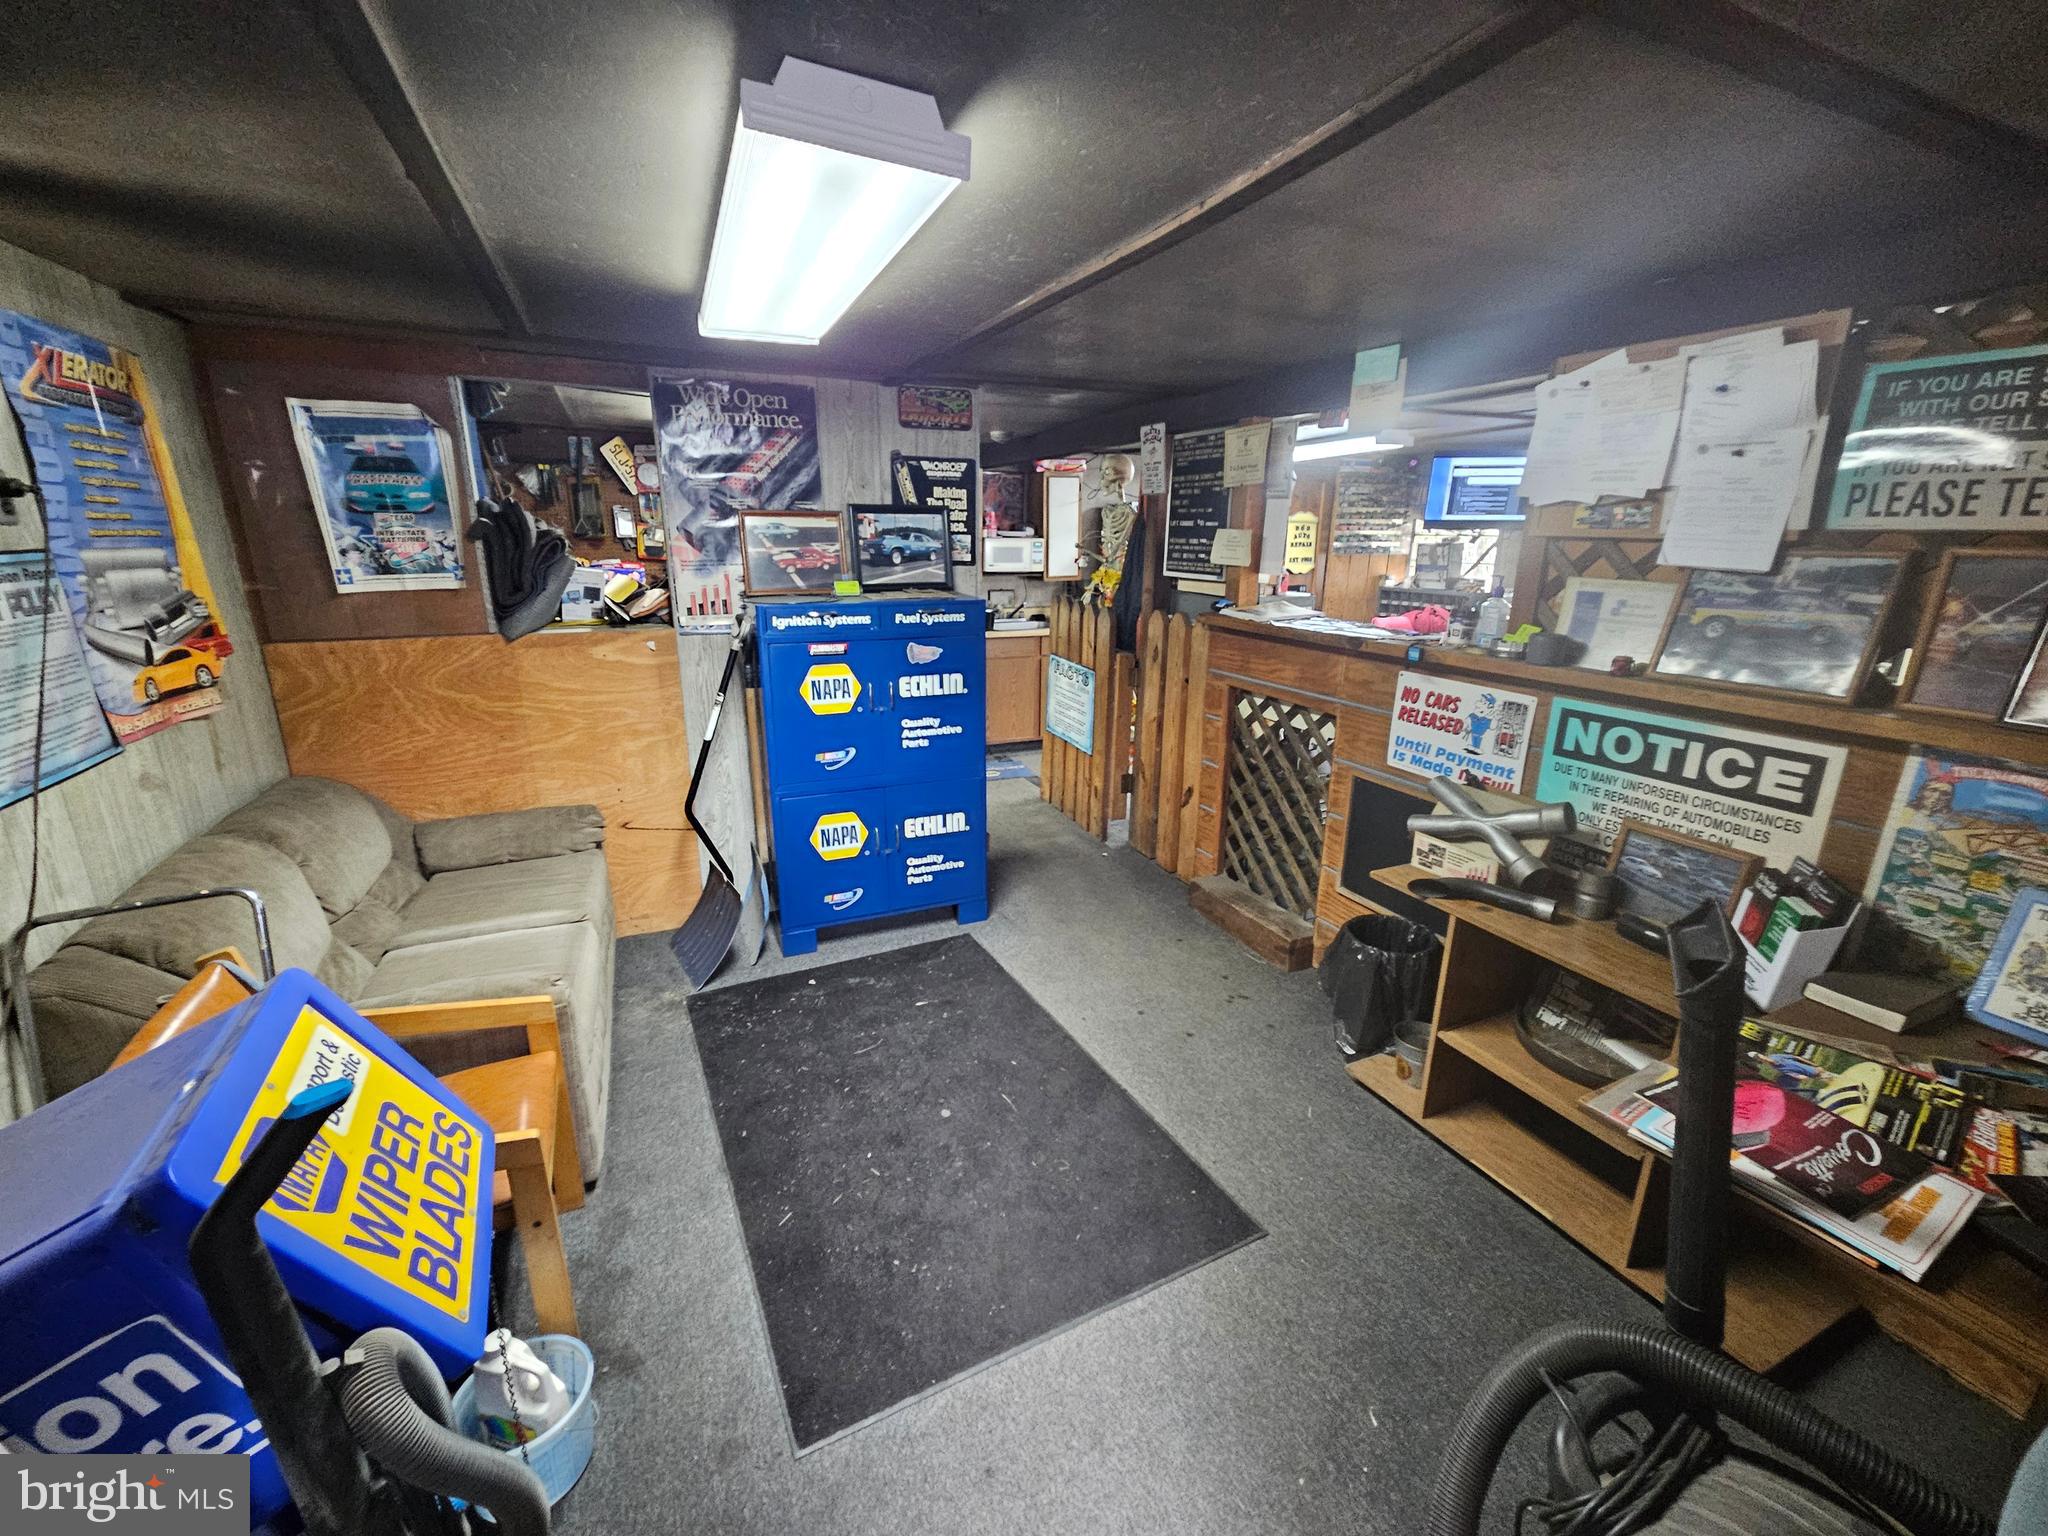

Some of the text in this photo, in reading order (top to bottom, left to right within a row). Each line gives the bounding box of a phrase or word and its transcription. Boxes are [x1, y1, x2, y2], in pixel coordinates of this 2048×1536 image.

[29, 341, 128, 394] XLERATOR
[1887, 380, 1911, 398] IF
[1918, 374, 1969, 394] YOU
[1973, 367, 2034, 390] ARE
[676, 384, 788, 412] Wide Open
[1899, 391, 2030, 417] WITH OUR
[670, 403, 803, 429] Pformance.
[1973, 414, 2038, 433] TELL
[921, 461, 967, 472] MONROE
[926, 497, 967, 510] The Road
[933, 486, 967, 500] Making
[1843, 476, 2048, 518] PLEASE TE
[949, 511, 967, 521] afer
[771, 614, 871, 630] Ignition Systems
[895, 612, 966, 625] Fuel Systems
[811, 677, 852, 701] NAPA
[1400, 685, 1462, 714] NO CARS
[901, 716, 941, 729] Quality
[901, 724, 963, 739] Automotive
[1398, 705, 1465, 736] RELEASED
[902, 738, 930, 749] Parts
[1392, 749, 1406, 762] Is
[1410, 754, 1454, 777] Made
[1394, 735, 1516, 780] Until Payment
[1562, 716, 1812, 803] NOTICE
[1554, 761, 1803, 834] DUE TO MANY UNFORSEEN CIRCUMSTANCES
[1569, 781, 1580, 792] IN
[1581, 783, 1601, 798] THE
[1603, 789, 1661, 814] REPAIRING
[1663, 805, 1680, 817] OF
[1592, 801, 1608, 814] WE
[1578, 811, 1622, 833] ONLY ES
[821, 825, 859, 848] NAPA
[906, 853, 944, 867] Quality
[906, 860, 965, 876] Automotive
[907, 874, 933, 885] Parts
[307, 1039, 340, 1090] port &
[344, 1100, 425, 1260] WIPER
[408, 1110, 474, 1302] BLADES
